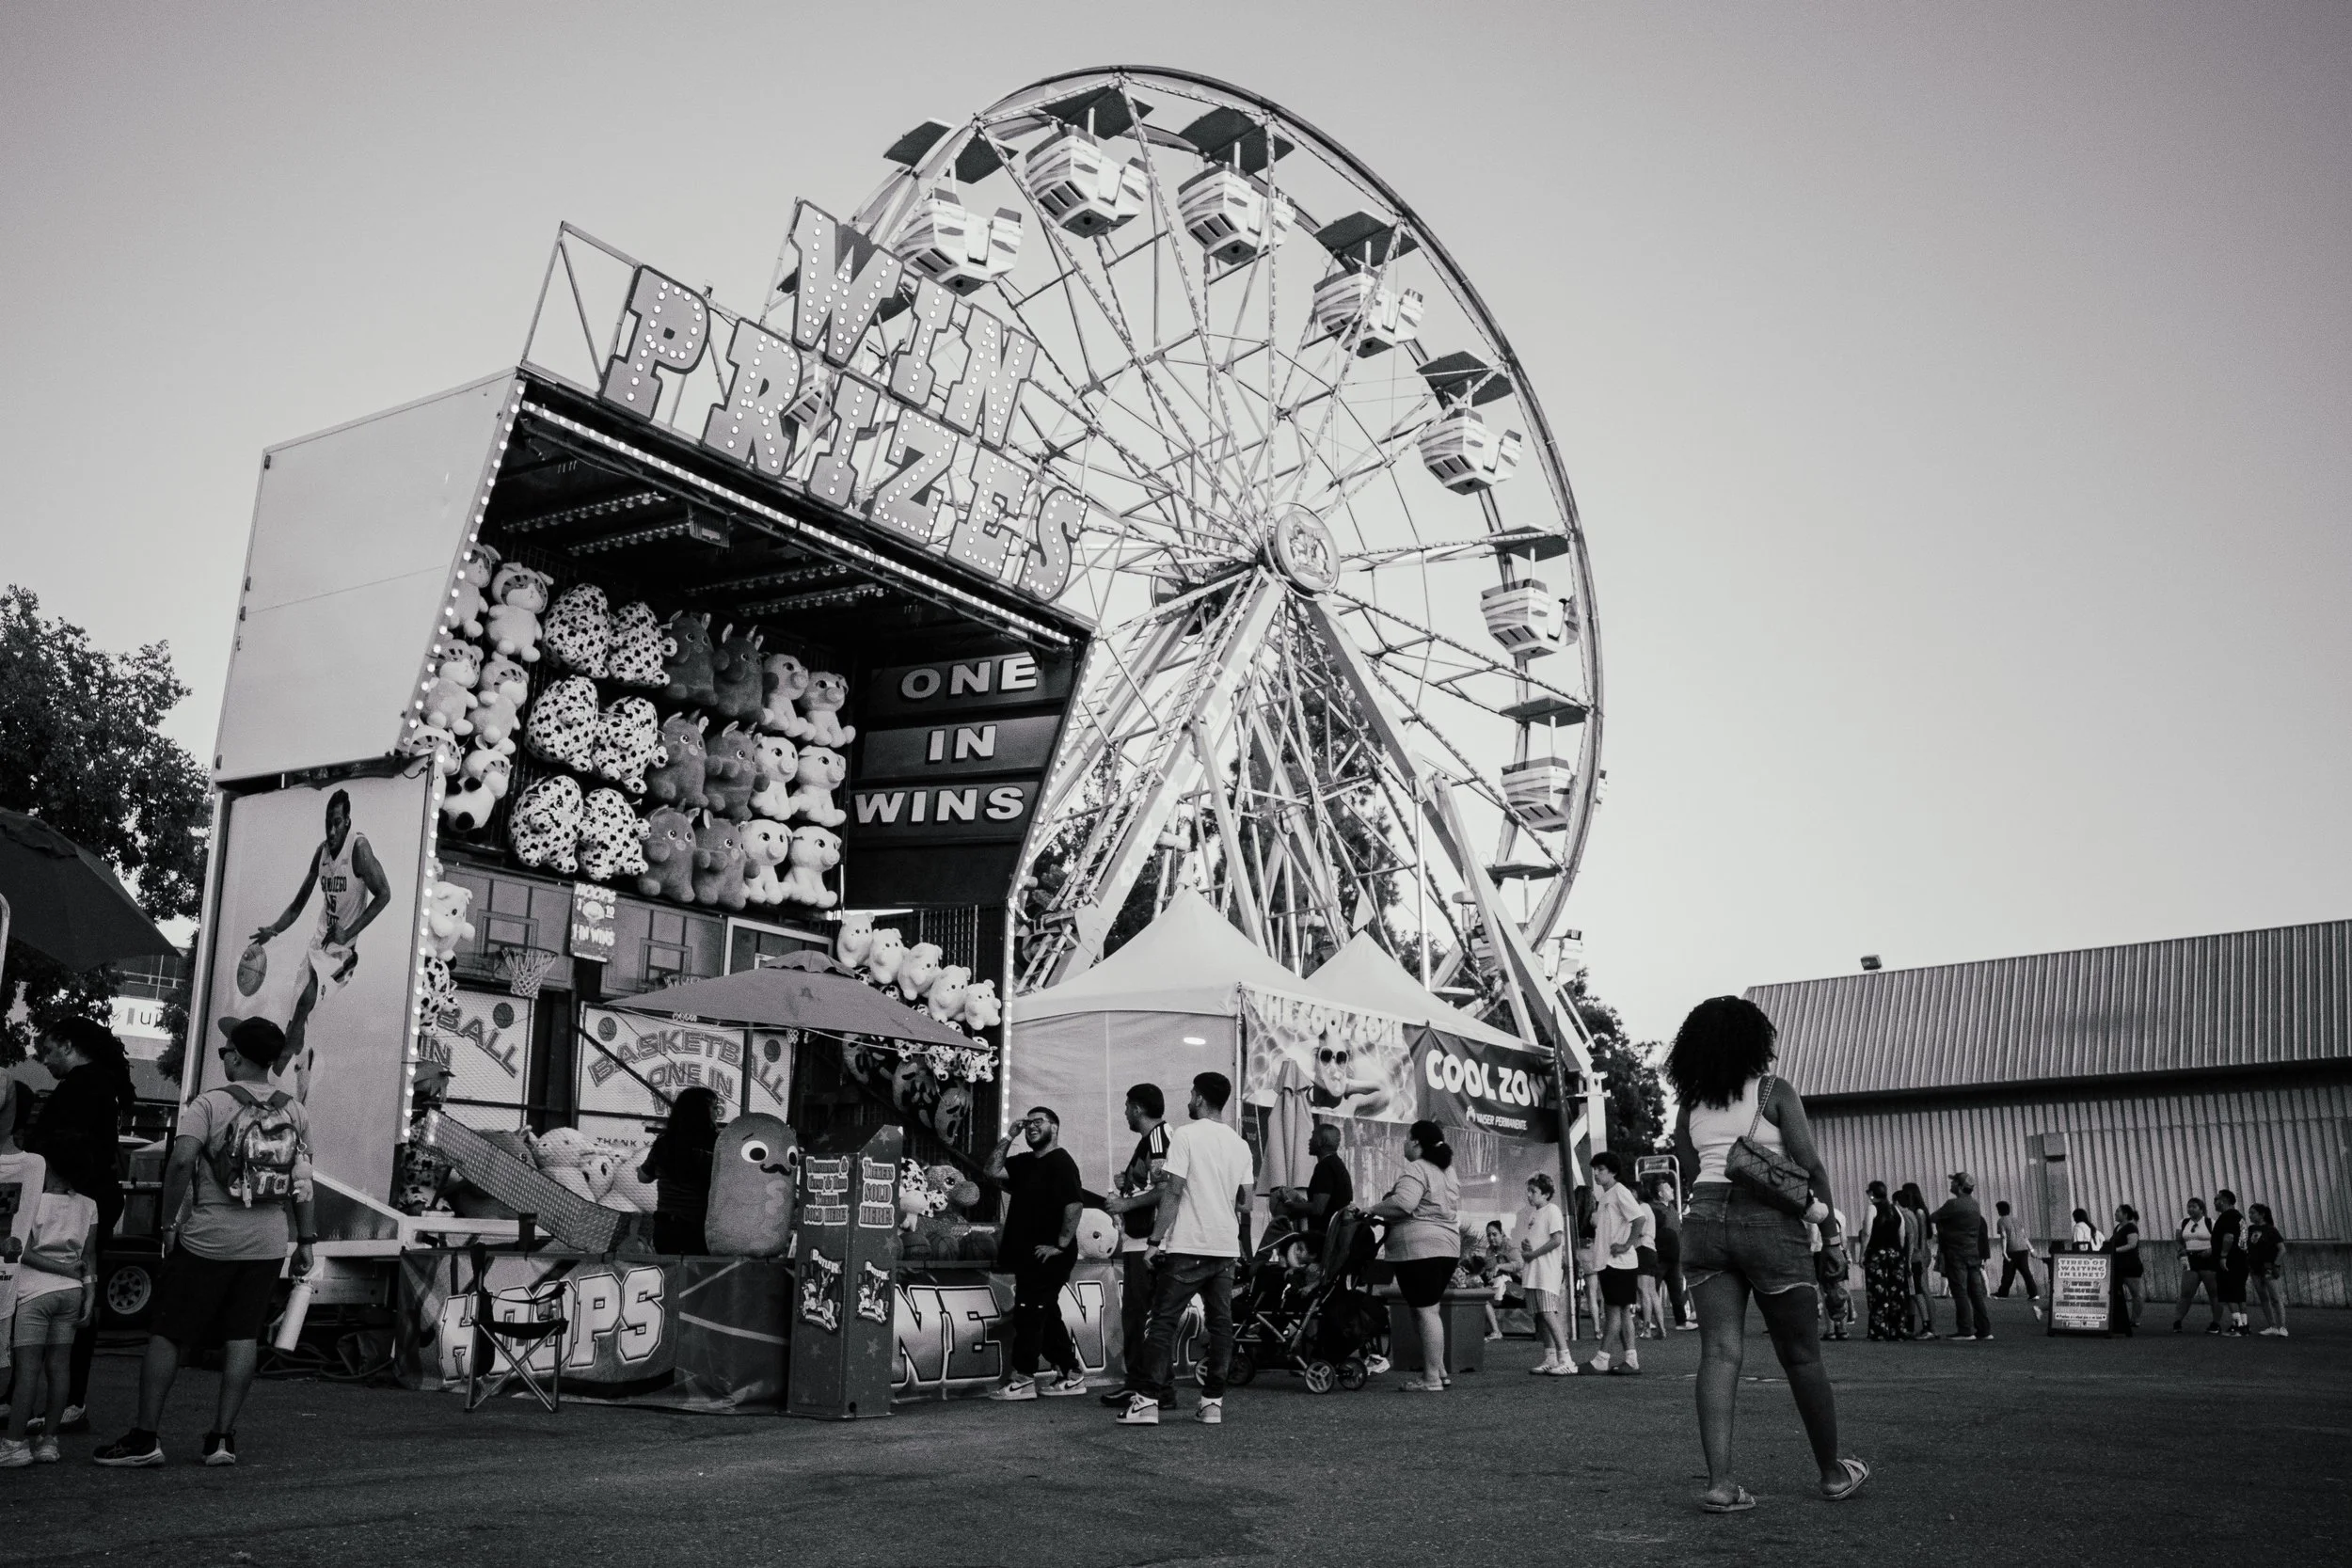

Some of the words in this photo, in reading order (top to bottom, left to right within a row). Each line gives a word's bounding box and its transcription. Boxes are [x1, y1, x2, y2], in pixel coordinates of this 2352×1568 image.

[791, 199, 1039, 450] WIN
[597, 263, 1087, 602] PRIZES
[900, 657, 1038, 700] ONE
[926, 724, 997, 762] IN
[854, 786, 1025, 825] WINS
[575, 882, 616, 903] HOOPS
[579, 924, 590, 942] IN
[590, 927, 616, 947] WINS
[587, 1029, 785, 1106] BASKETBLL
[646, 1060, 703, 1089] ONE
[707, 1066, 734, 1100] IN
[1425, 1048, 1497, 1101] COOL
[1497, 1066, 1549, 1108] ZON
[596, 1136, 638, 1148] THANK
[1494, 1115, 1529, 1132] PERMANENTE
[864, 1181, 892, 1203] SOLD
[860, 1204, 894, 1226] HERE!
